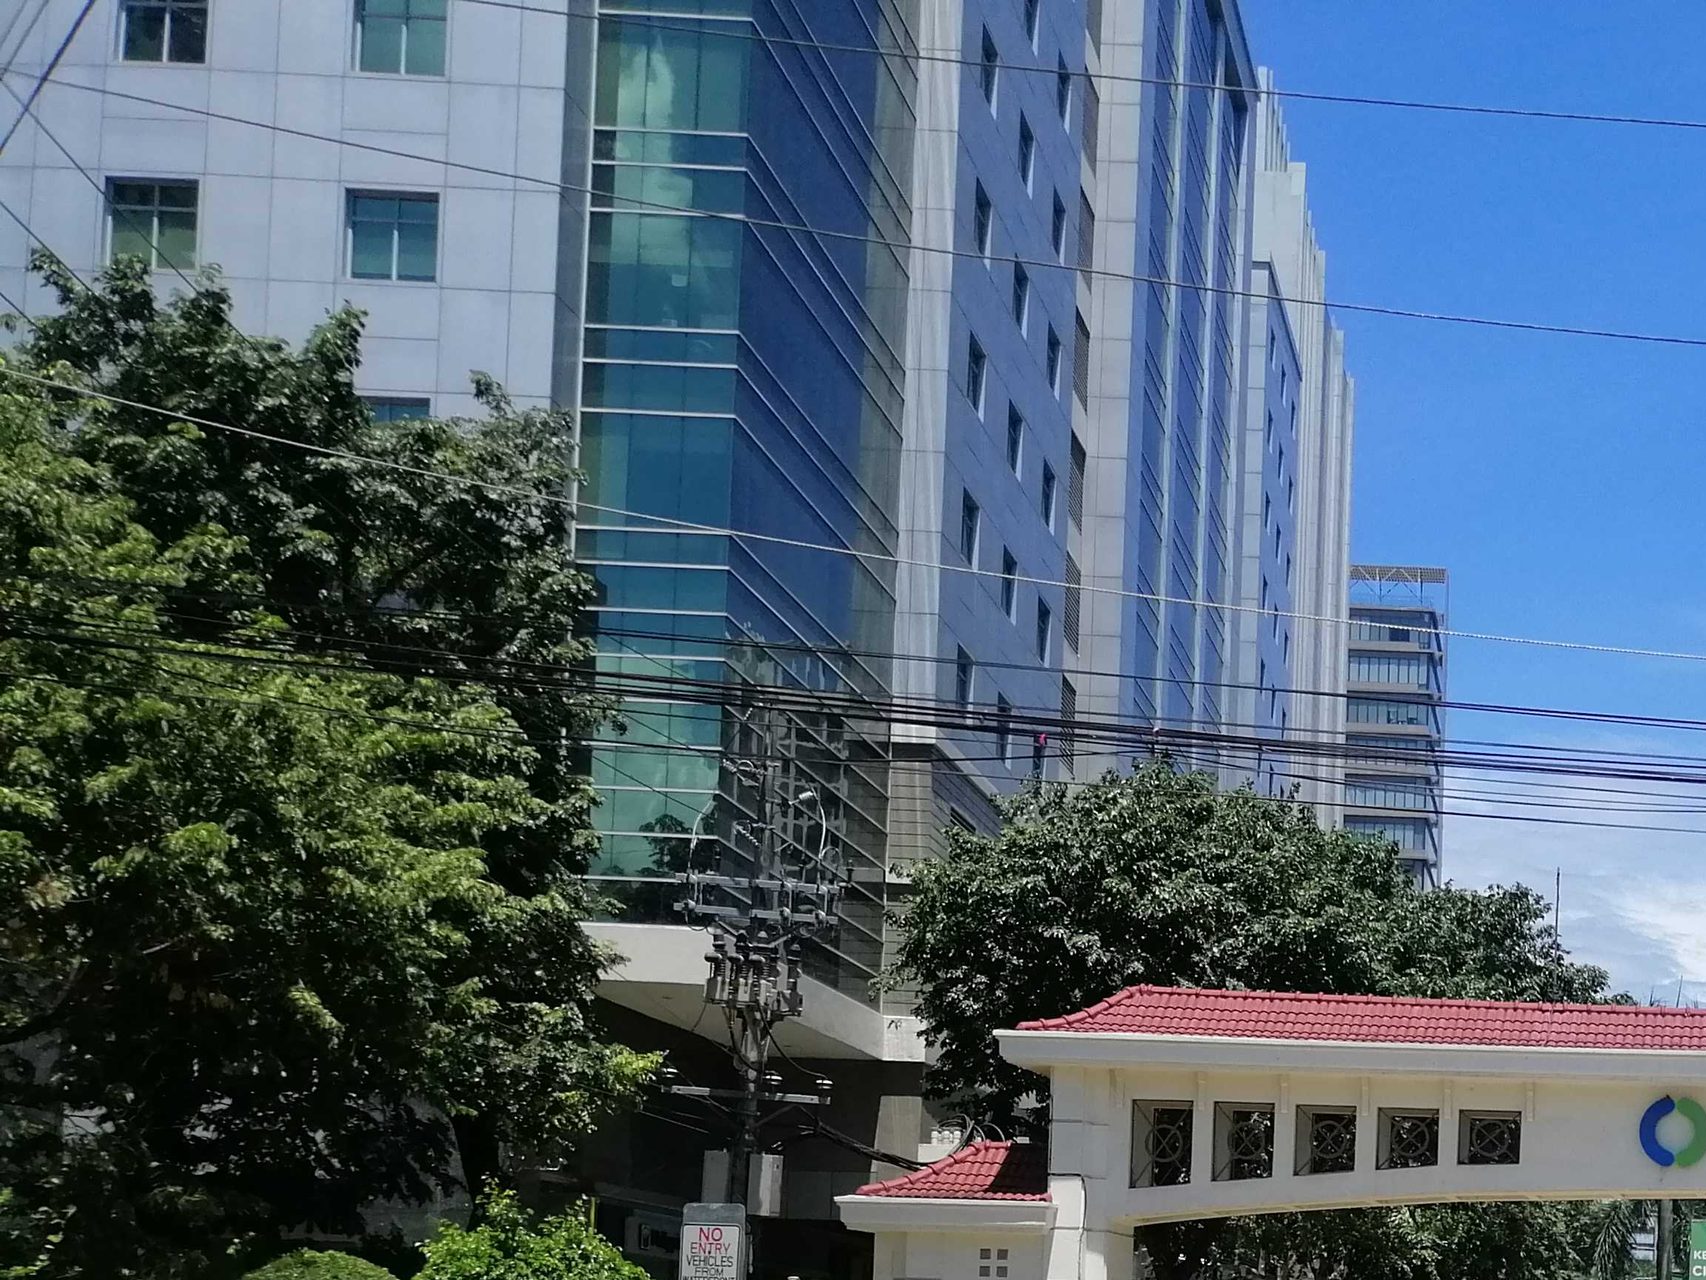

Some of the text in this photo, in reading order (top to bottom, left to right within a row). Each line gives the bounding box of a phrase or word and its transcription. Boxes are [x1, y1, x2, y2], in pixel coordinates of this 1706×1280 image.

[699, 1227, 723, 1241] NO
[690, 1242, 730, 1254] ENTRY
[686, 1254, 734, 1267] VEHICLES
[695, 1267, 724, 1276] FROM
